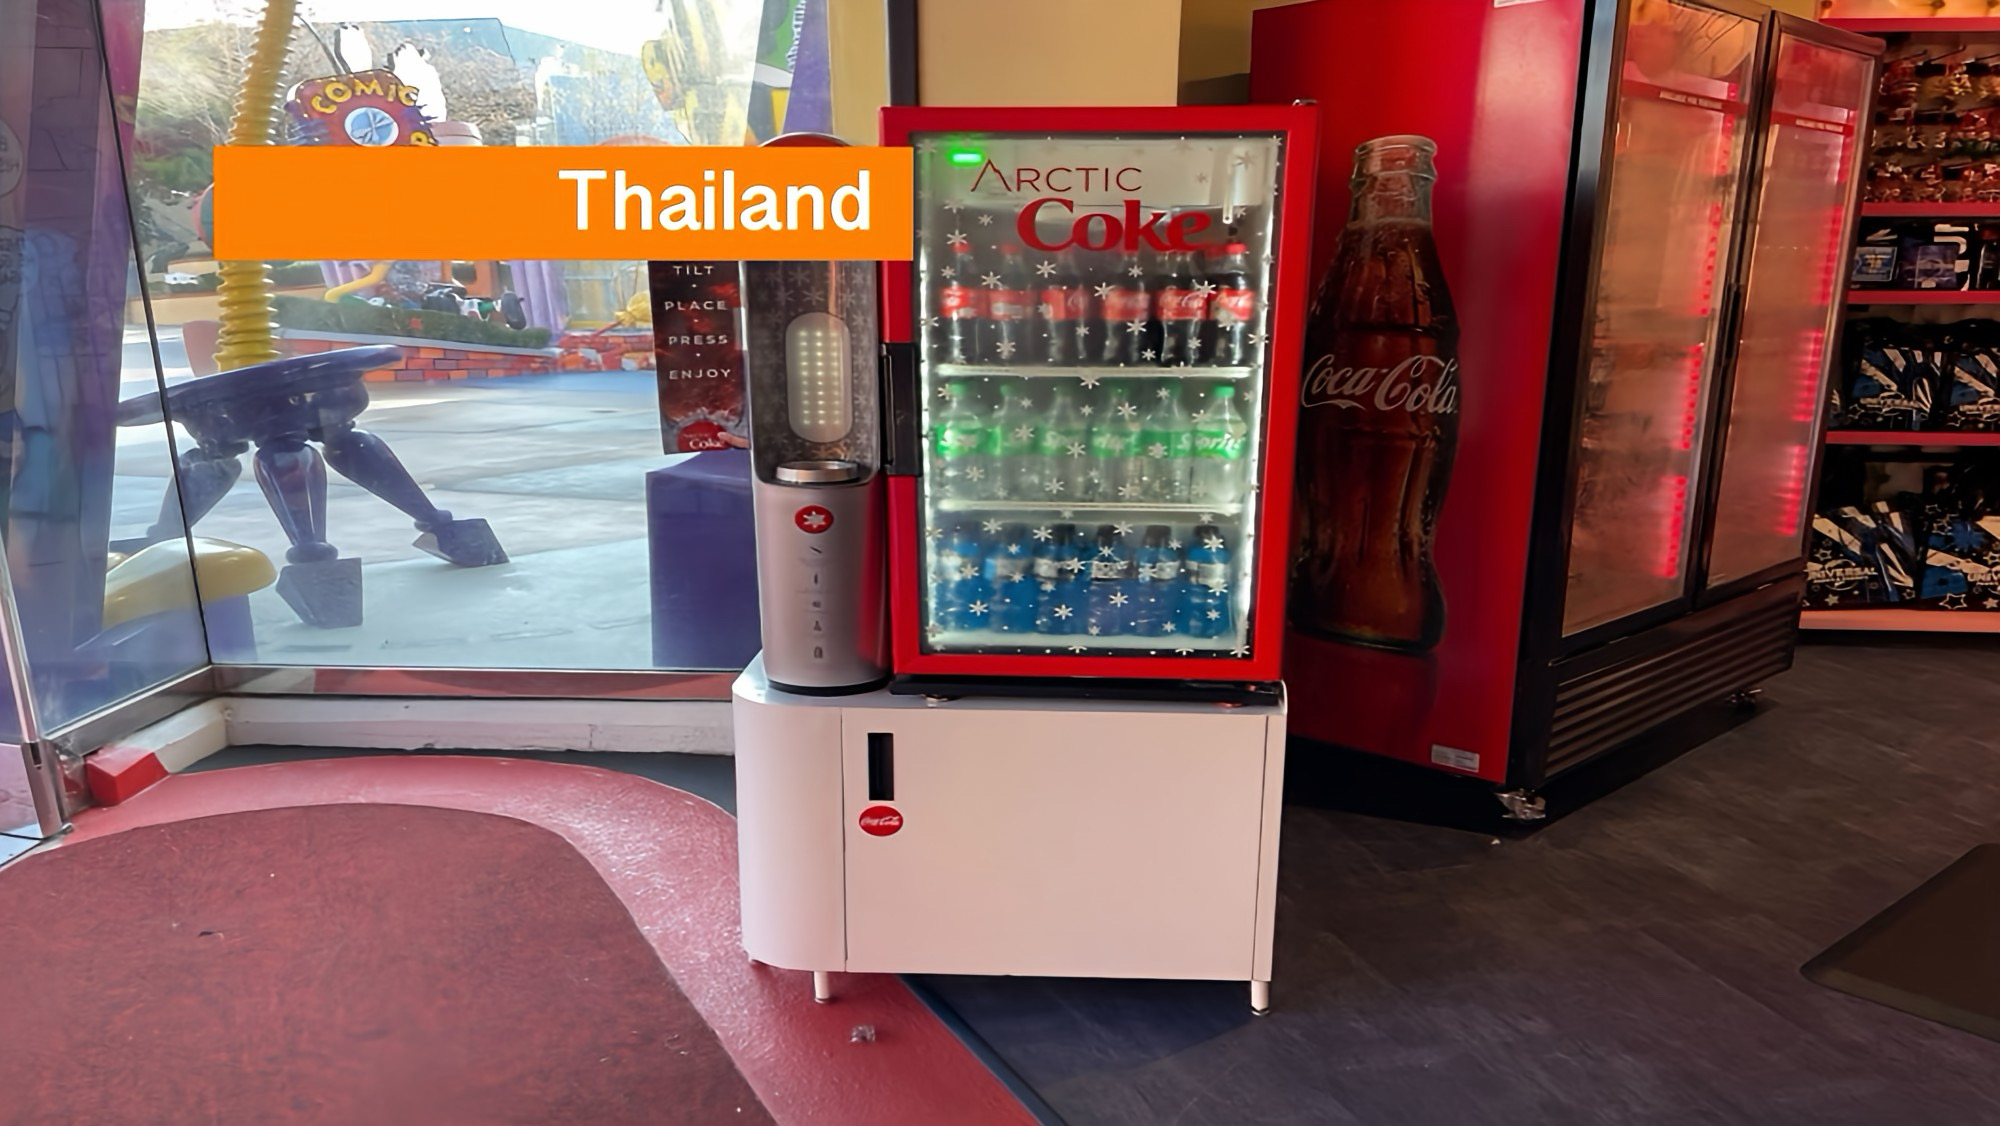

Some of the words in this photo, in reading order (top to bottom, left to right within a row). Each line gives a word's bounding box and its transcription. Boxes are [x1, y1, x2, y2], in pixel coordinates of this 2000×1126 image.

[311, 78, 419, 115] COMIC
[971, 159, 1142, 192] ARCTIC
[1016, 197, 1212, 252] Coke
[672, 265, 714, 276] TILT
[664, 300, 728, 311] PLACE
[668, 334, 728, 345] PRESS
[669, 368, 731, 380] ENJOY
[1302, 354, 1458, 414] Coca-Cola
